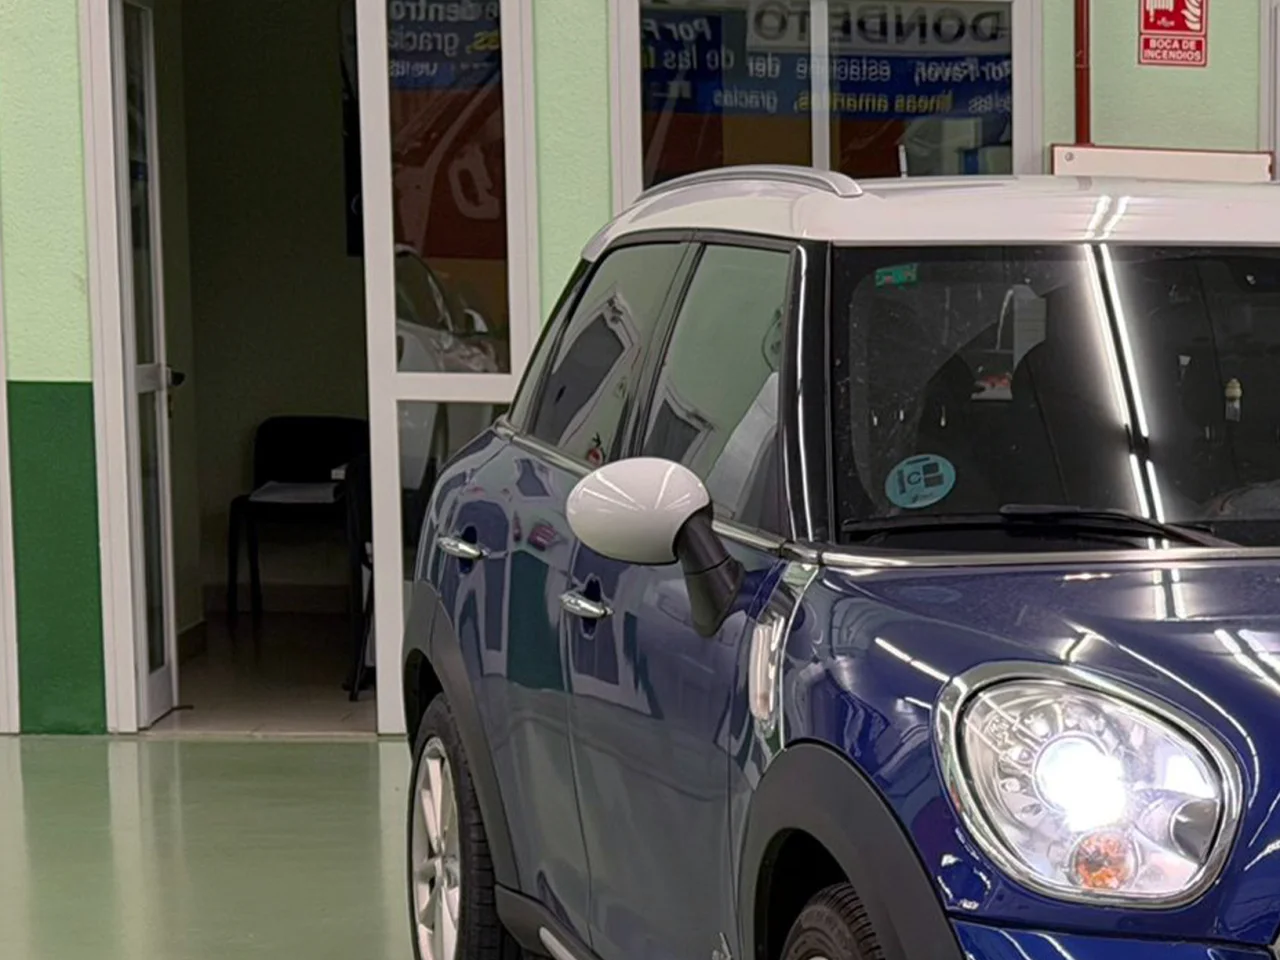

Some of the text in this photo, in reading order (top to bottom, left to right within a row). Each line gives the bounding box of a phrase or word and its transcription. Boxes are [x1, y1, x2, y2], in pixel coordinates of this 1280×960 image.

[1149, 38, 1196, 50] BOCA DE
[1143, 49, 1201, 61] INCENDIOS
